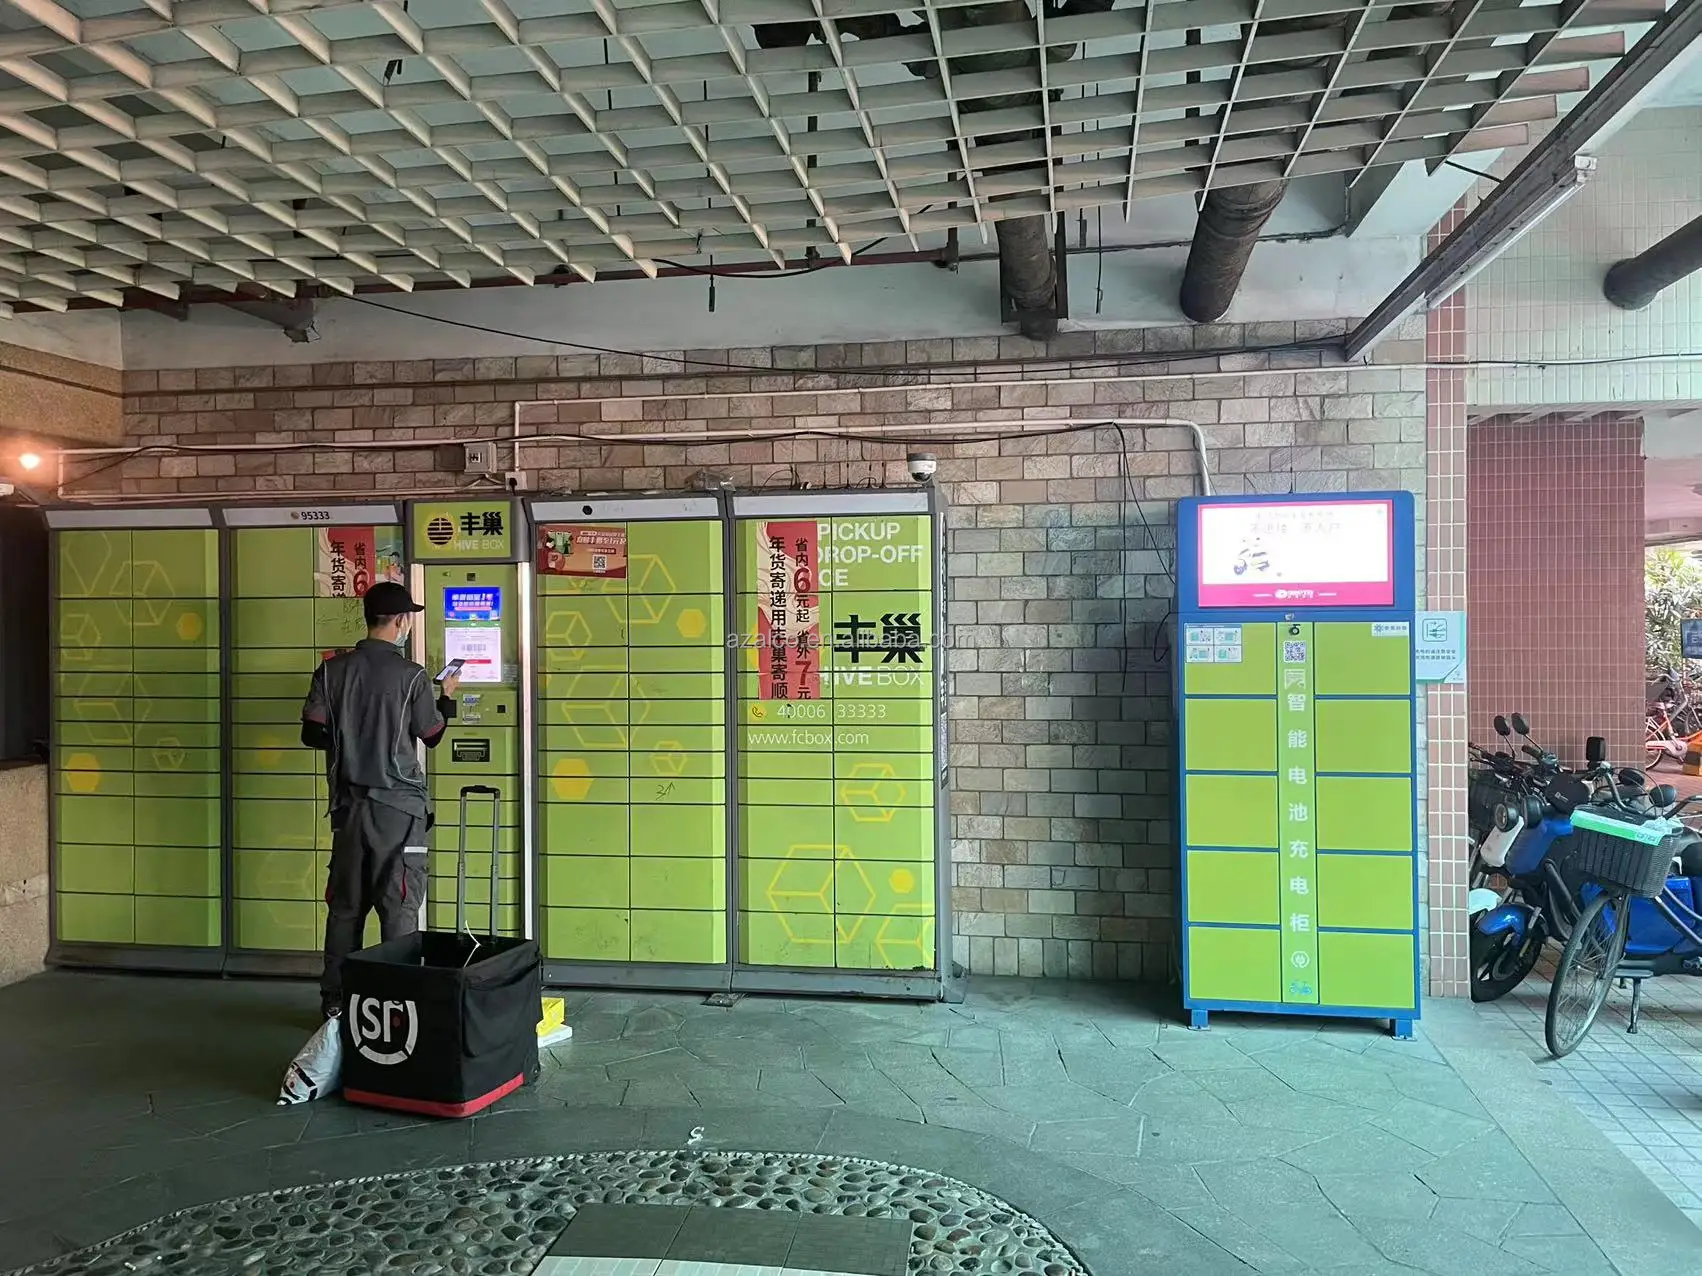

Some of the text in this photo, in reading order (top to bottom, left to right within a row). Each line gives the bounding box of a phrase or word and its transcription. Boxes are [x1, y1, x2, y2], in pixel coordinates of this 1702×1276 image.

[301, 511, 330, 520] 95333
[460, 511, 504, 536] 丰巢
[817, 522, 901, 541] PICKUP
[453, 540, 504, 550] HIVE BOX
[834, 613, 926, 663] 丰巢
[877, 664, 924, 686] BOX
[776, 704, 887, 719] 40006 33333
[747, 728, 869, 745] www.fcbox.com
